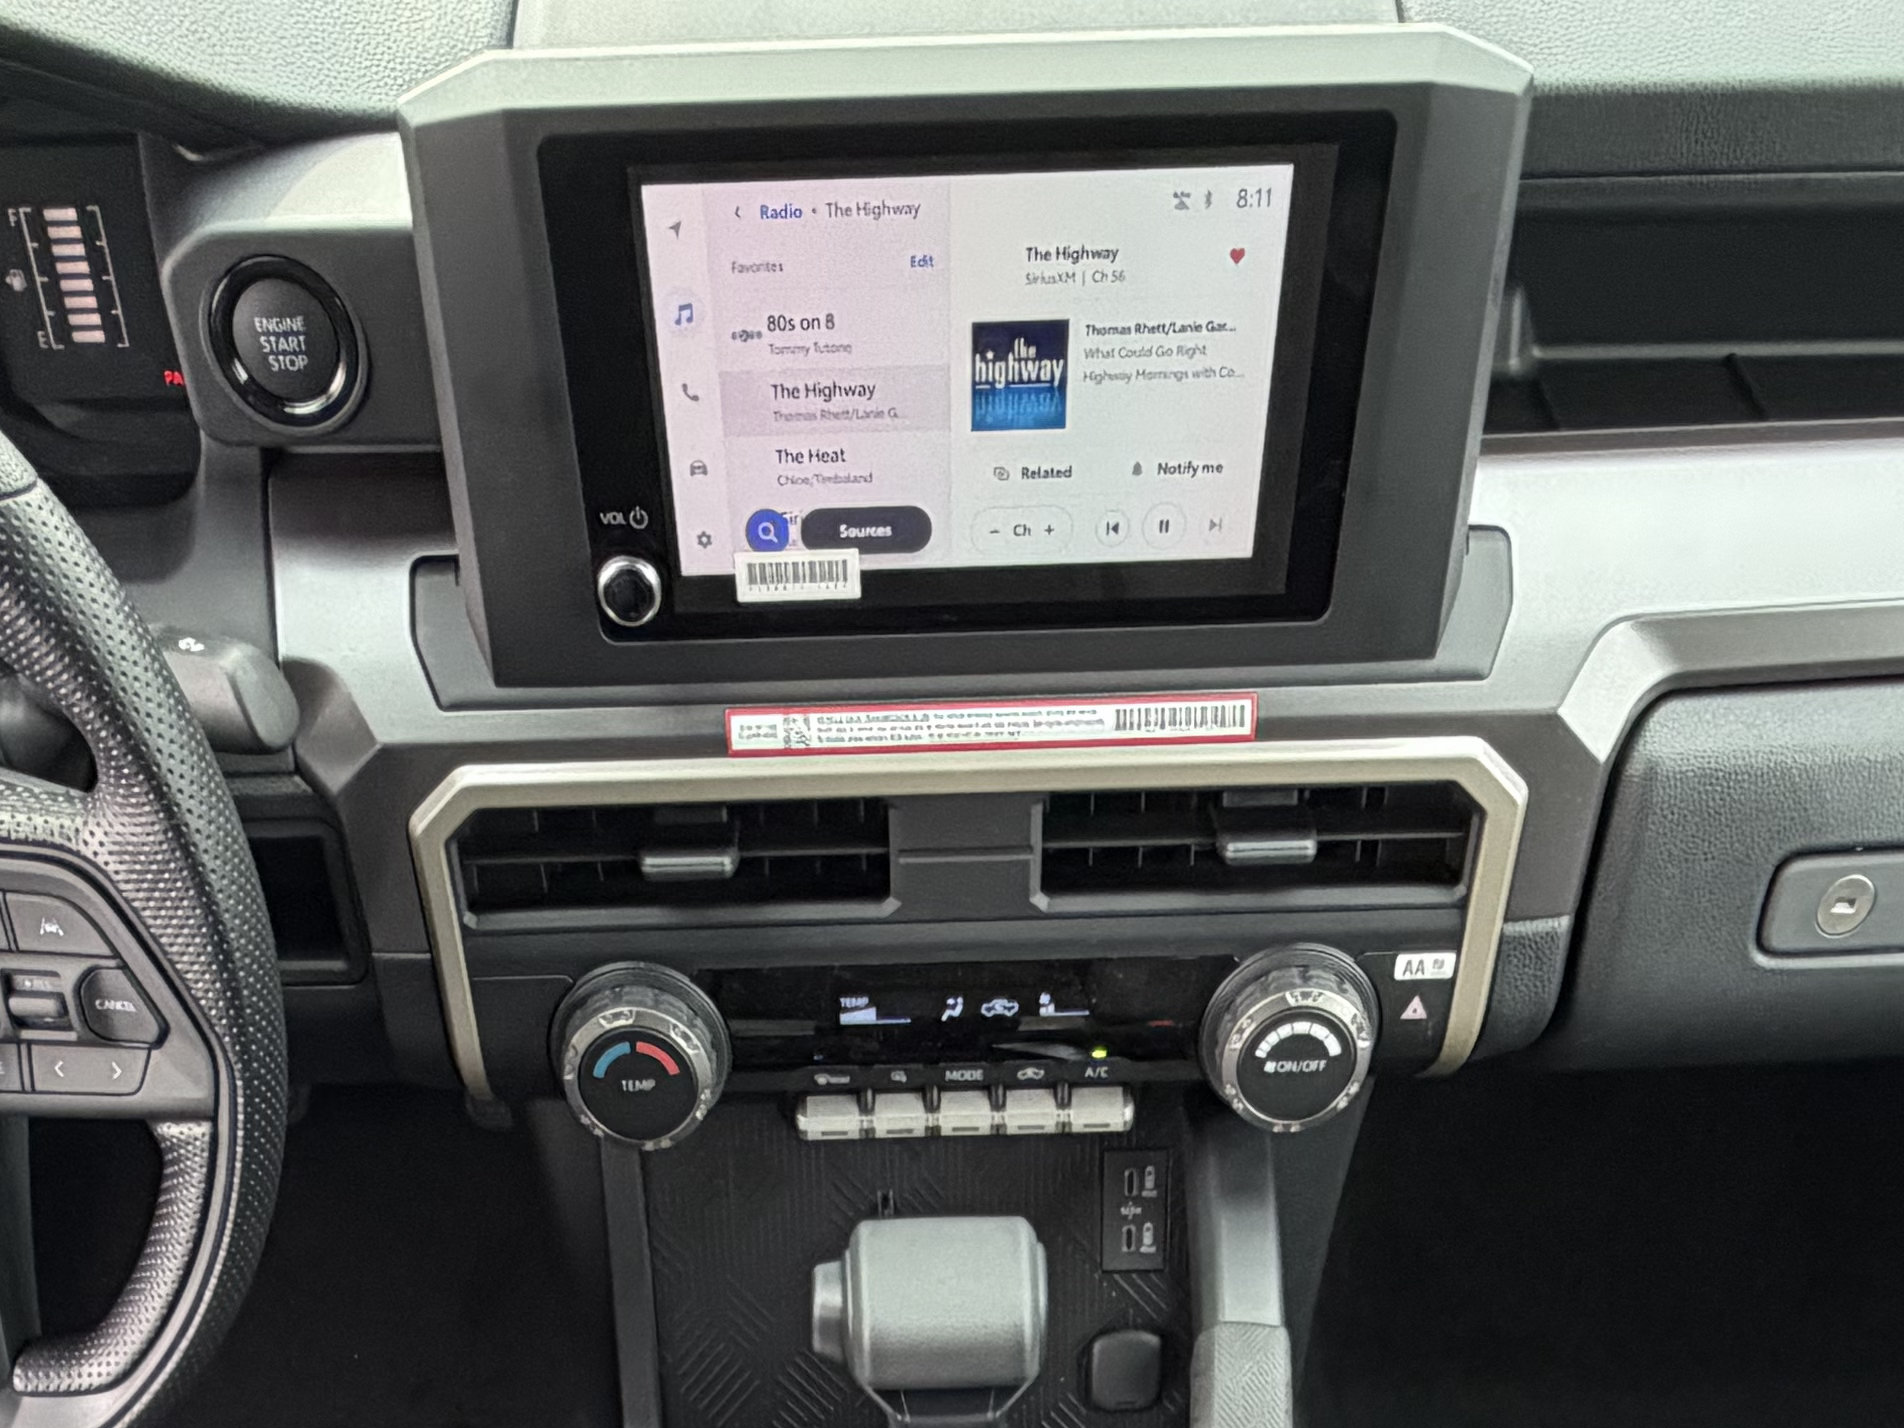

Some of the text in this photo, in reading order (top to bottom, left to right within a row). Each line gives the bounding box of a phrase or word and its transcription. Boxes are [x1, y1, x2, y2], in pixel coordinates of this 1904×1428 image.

[1236, 188, 1272, 209] 8:11
[760, 199, 921, 220] Radio The Highway
[910, 254, 935, 268] Edit
[1025, 244, 1119, 265] The Highway
[1092, 271, 1108, 283] Ch
[254, 316, 305, 333] ENGINE
[767, 313, 796, 332] 80s
[800, 318, 821, 331] on
[1085, 323, 1132, 336] Thomas
[260, 335, 306, 353] START
[1014, 337, 1037, 360] the
[1155, 346, 1173, 358] Go
[268, 355, 309, 372] STOP
[975, 350, 1065, 389] highway
[771, 380, 876, 402] The Highway
[776, 447, 846, 465] The Heat
[1021, 460, 1224, 480] Related Notify me
[600, 512, 627, 525] VOL
[840, 523, 1032, 539] Sources Ch
[1402, 958, 1426, 976] AA
[946, 1068, 984, 1082] MODE
[1085, 1066, 1110, 1079] A/C
[621, 1078, 656, 1092] TEMP
